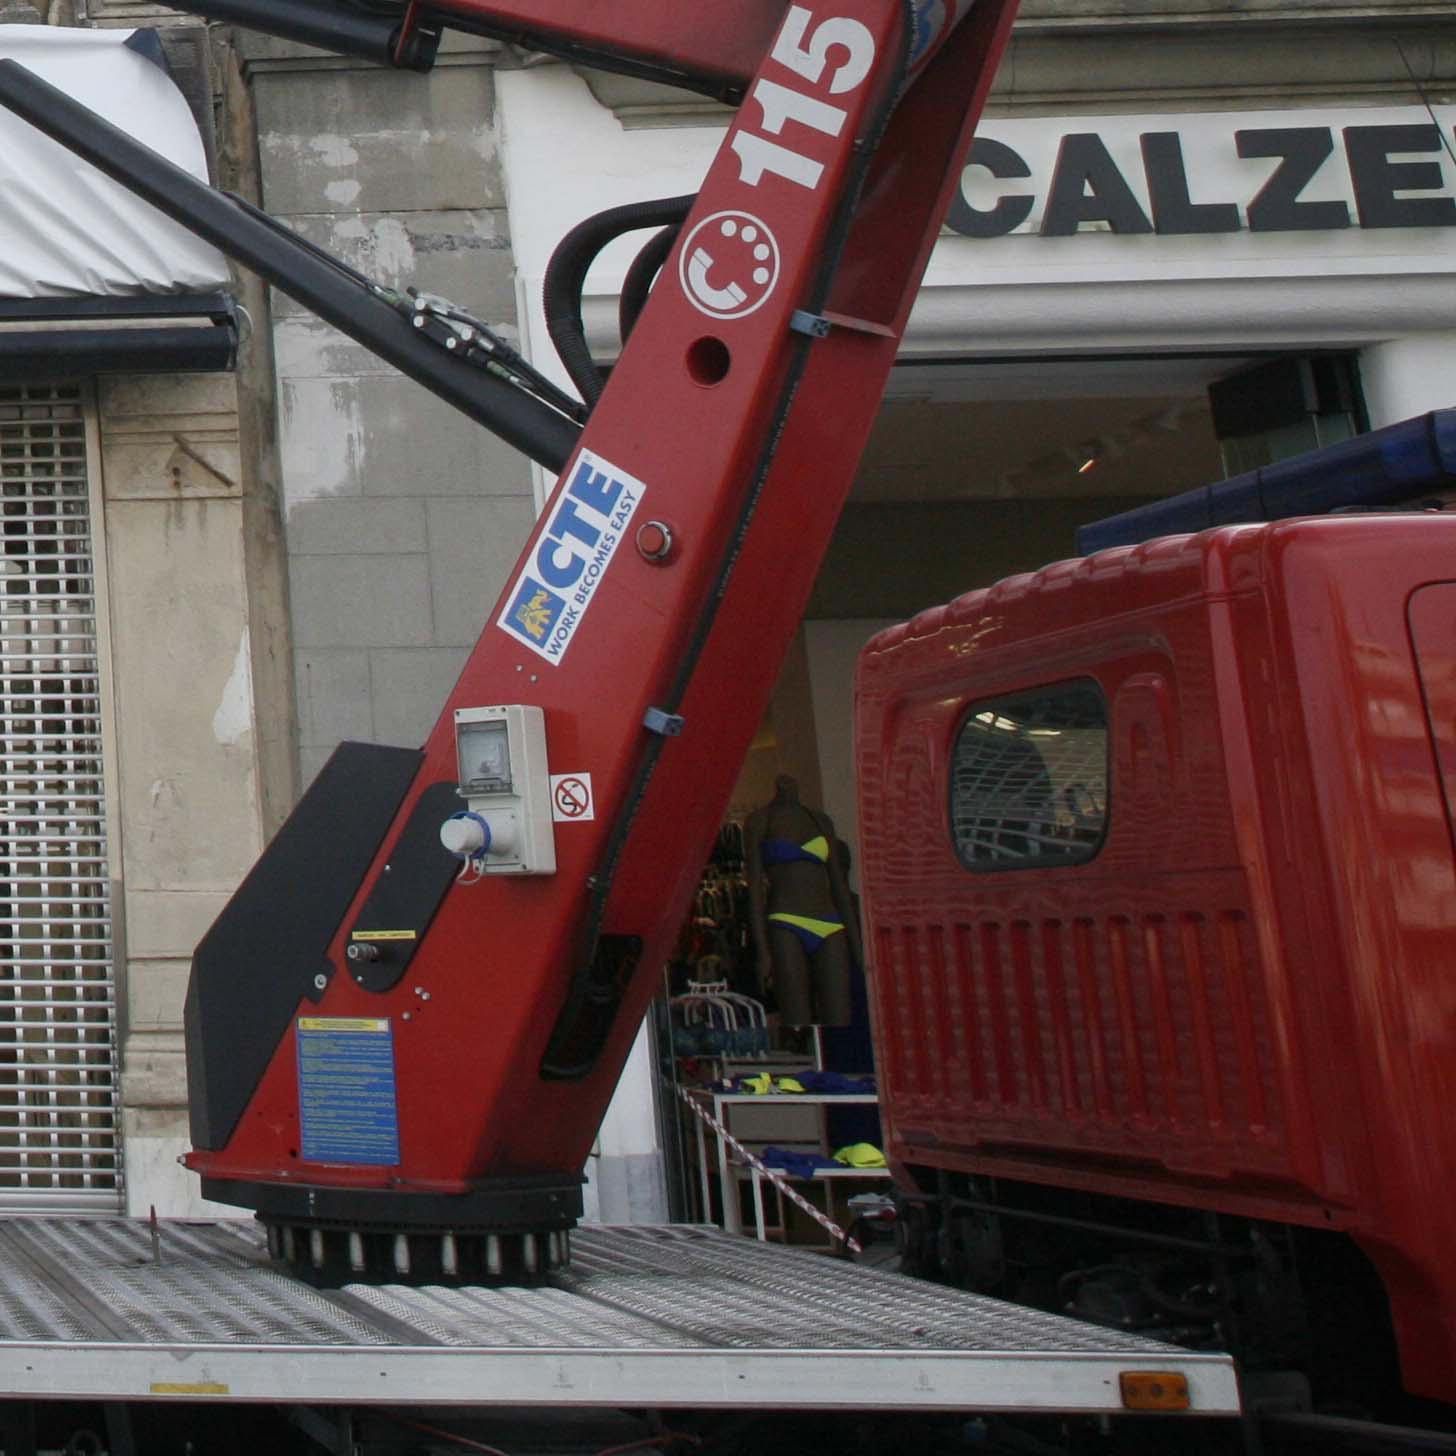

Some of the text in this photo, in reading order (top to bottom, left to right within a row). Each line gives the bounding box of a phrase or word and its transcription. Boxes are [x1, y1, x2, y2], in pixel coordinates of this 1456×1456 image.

[731, 5, 875, 190] 115
[942, 123, 1456, 238] CALZE
[536, 461, 624, 589] CTE
[547, 489, 637, 656] WORK BECOMES EASY
